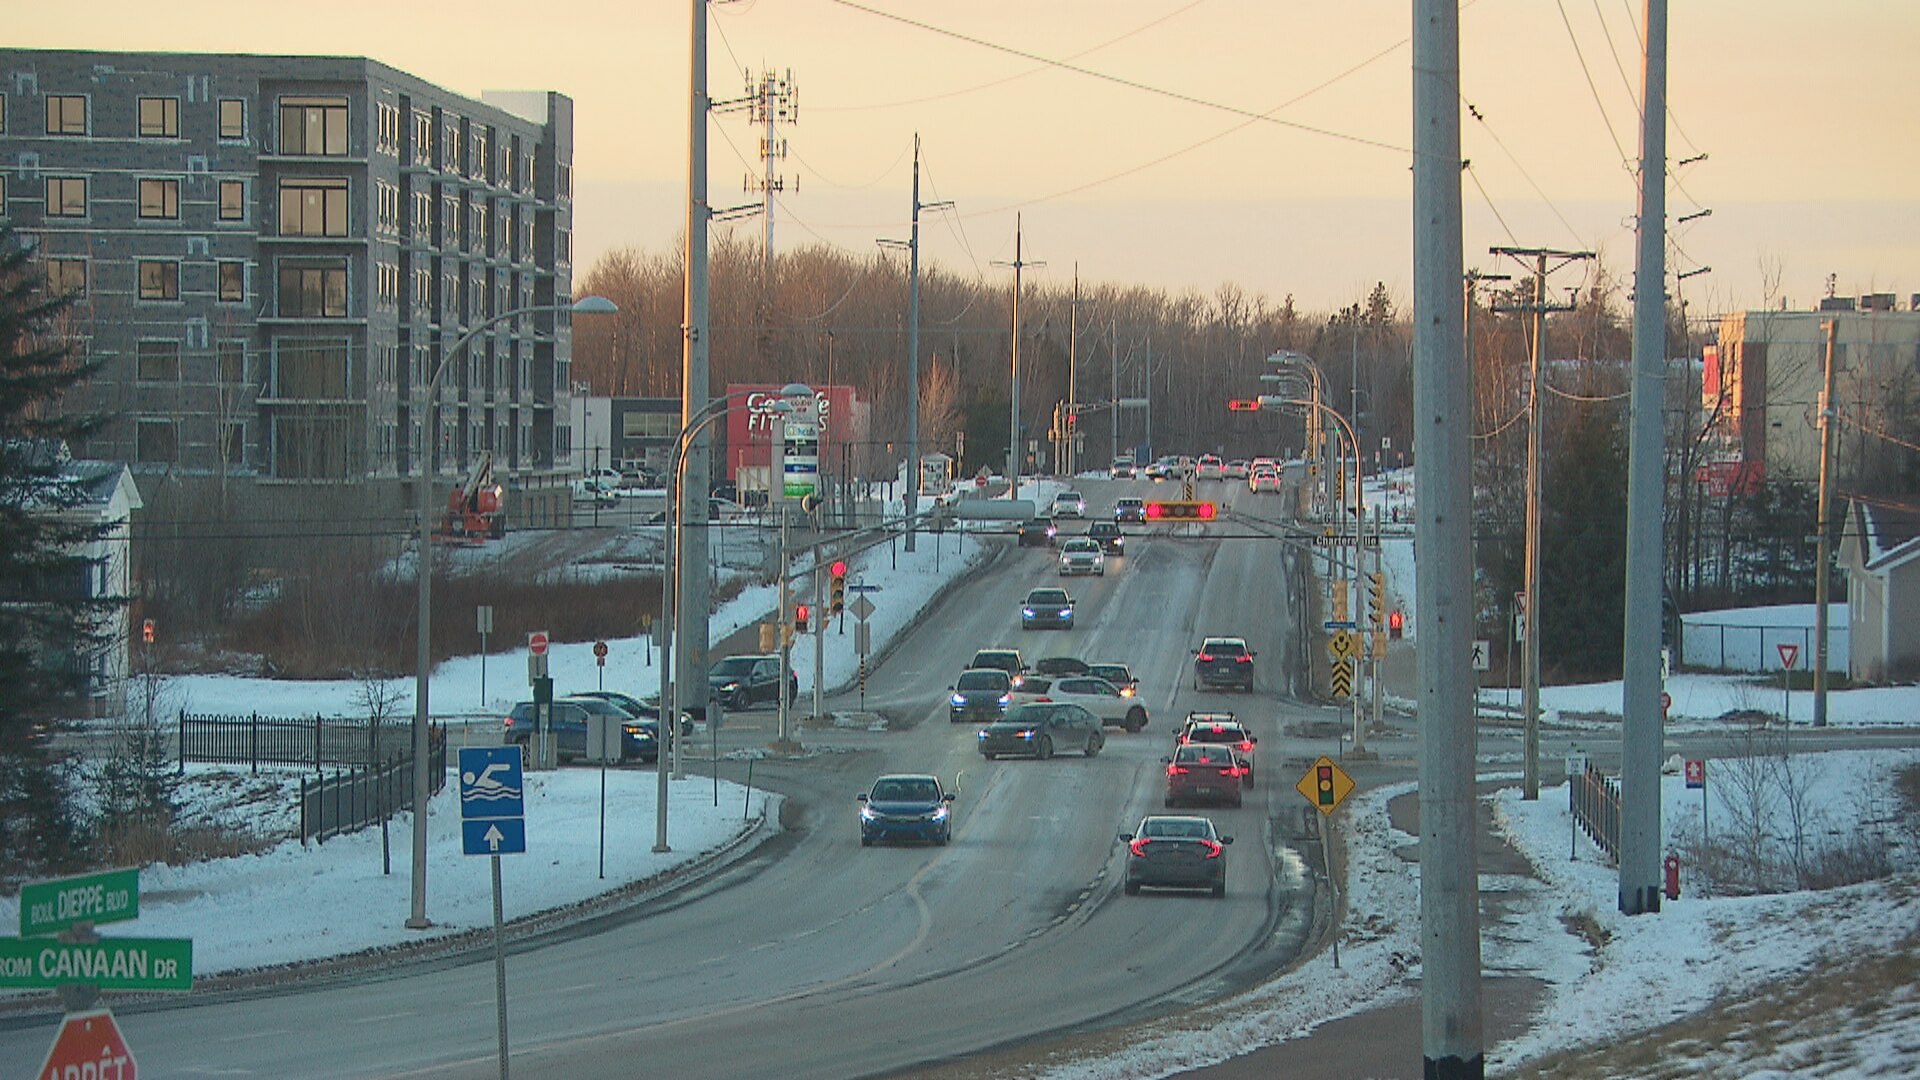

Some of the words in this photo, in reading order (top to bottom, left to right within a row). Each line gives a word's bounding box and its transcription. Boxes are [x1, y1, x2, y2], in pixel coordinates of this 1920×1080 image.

[748, 415, 828, 431] FITS
[1316, 536, 1377, 545] Charterslle
[58, 885, 103, 919] DIEPPE
[39, 948, 148, 979] CANAAN
[153, 958, 178, 979] DR
